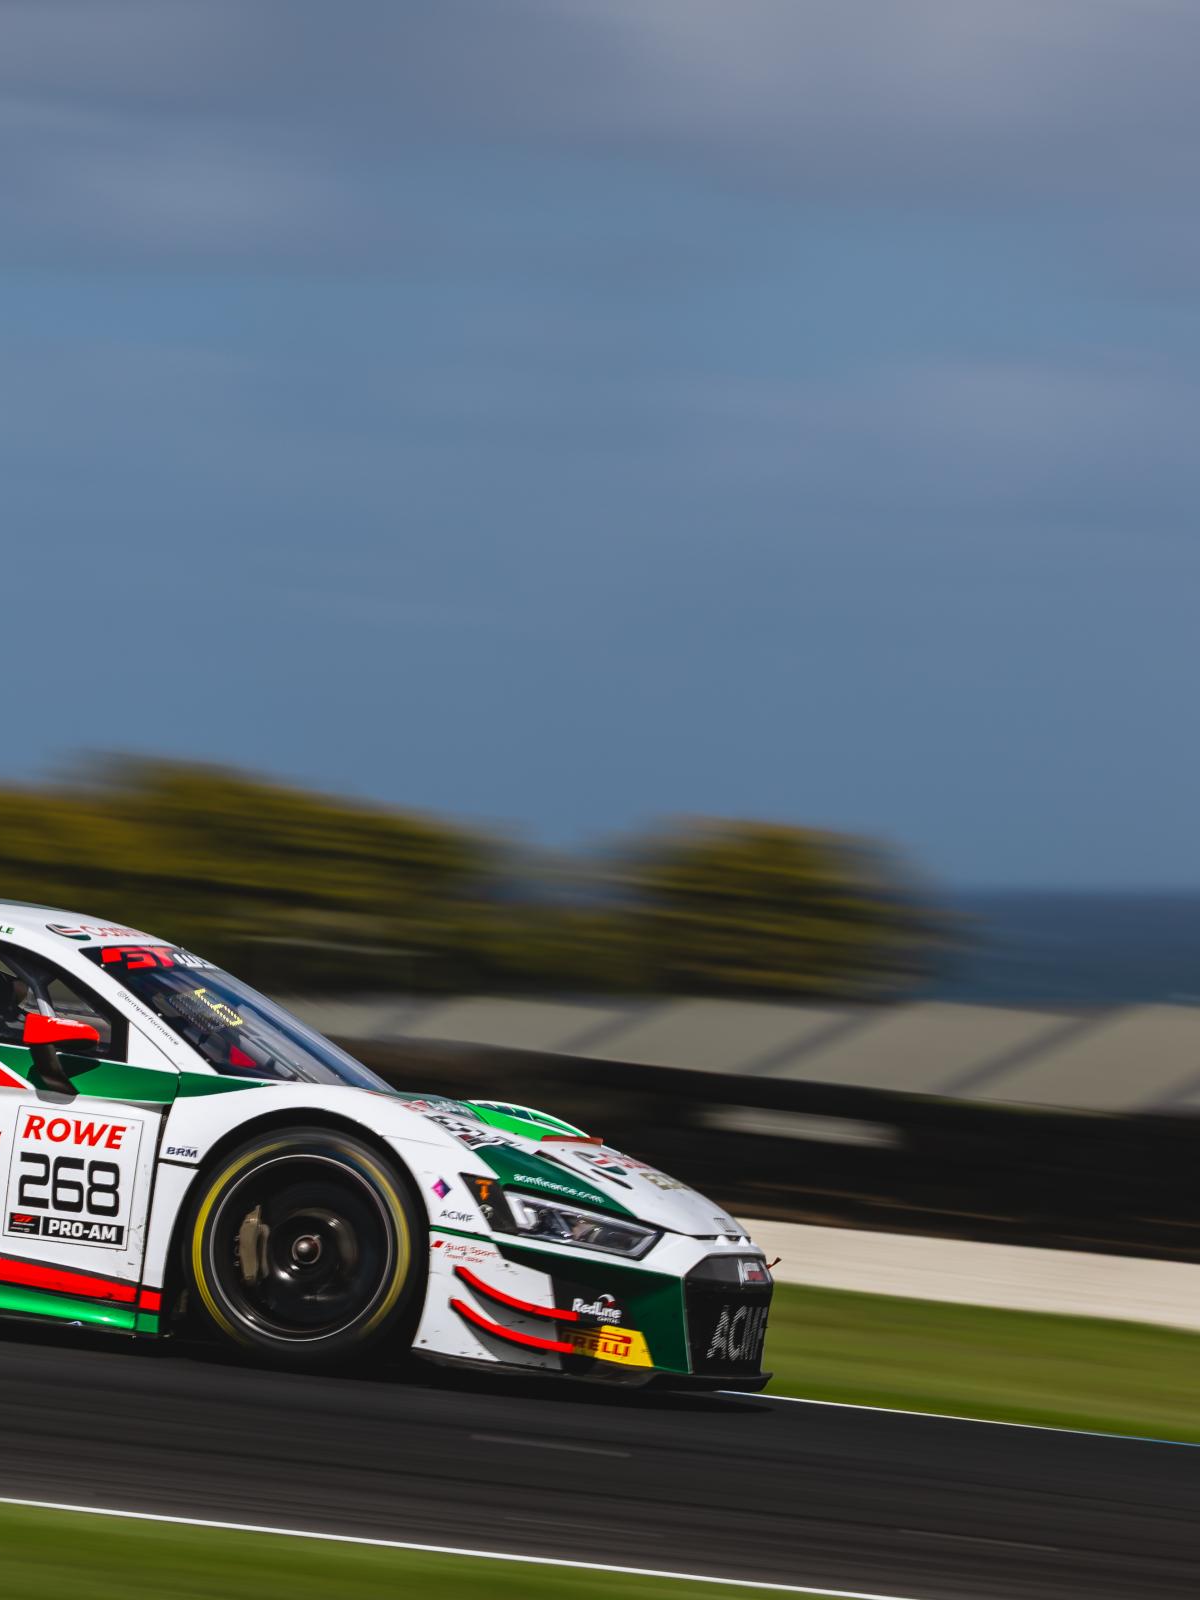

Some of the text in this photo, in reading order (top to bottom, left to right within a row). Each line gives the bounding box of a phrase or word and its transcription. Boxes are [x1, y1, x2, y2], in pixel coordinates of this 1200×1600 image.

[22, 1114, 128, 1150] ROWE
[166, 1146, 198, 1159] BRM
[18, 1152, 120, 1218] 268
[48, 1219, 118, 1242] PRO-AM
[572, 1297, 623, 1319] RedLine
